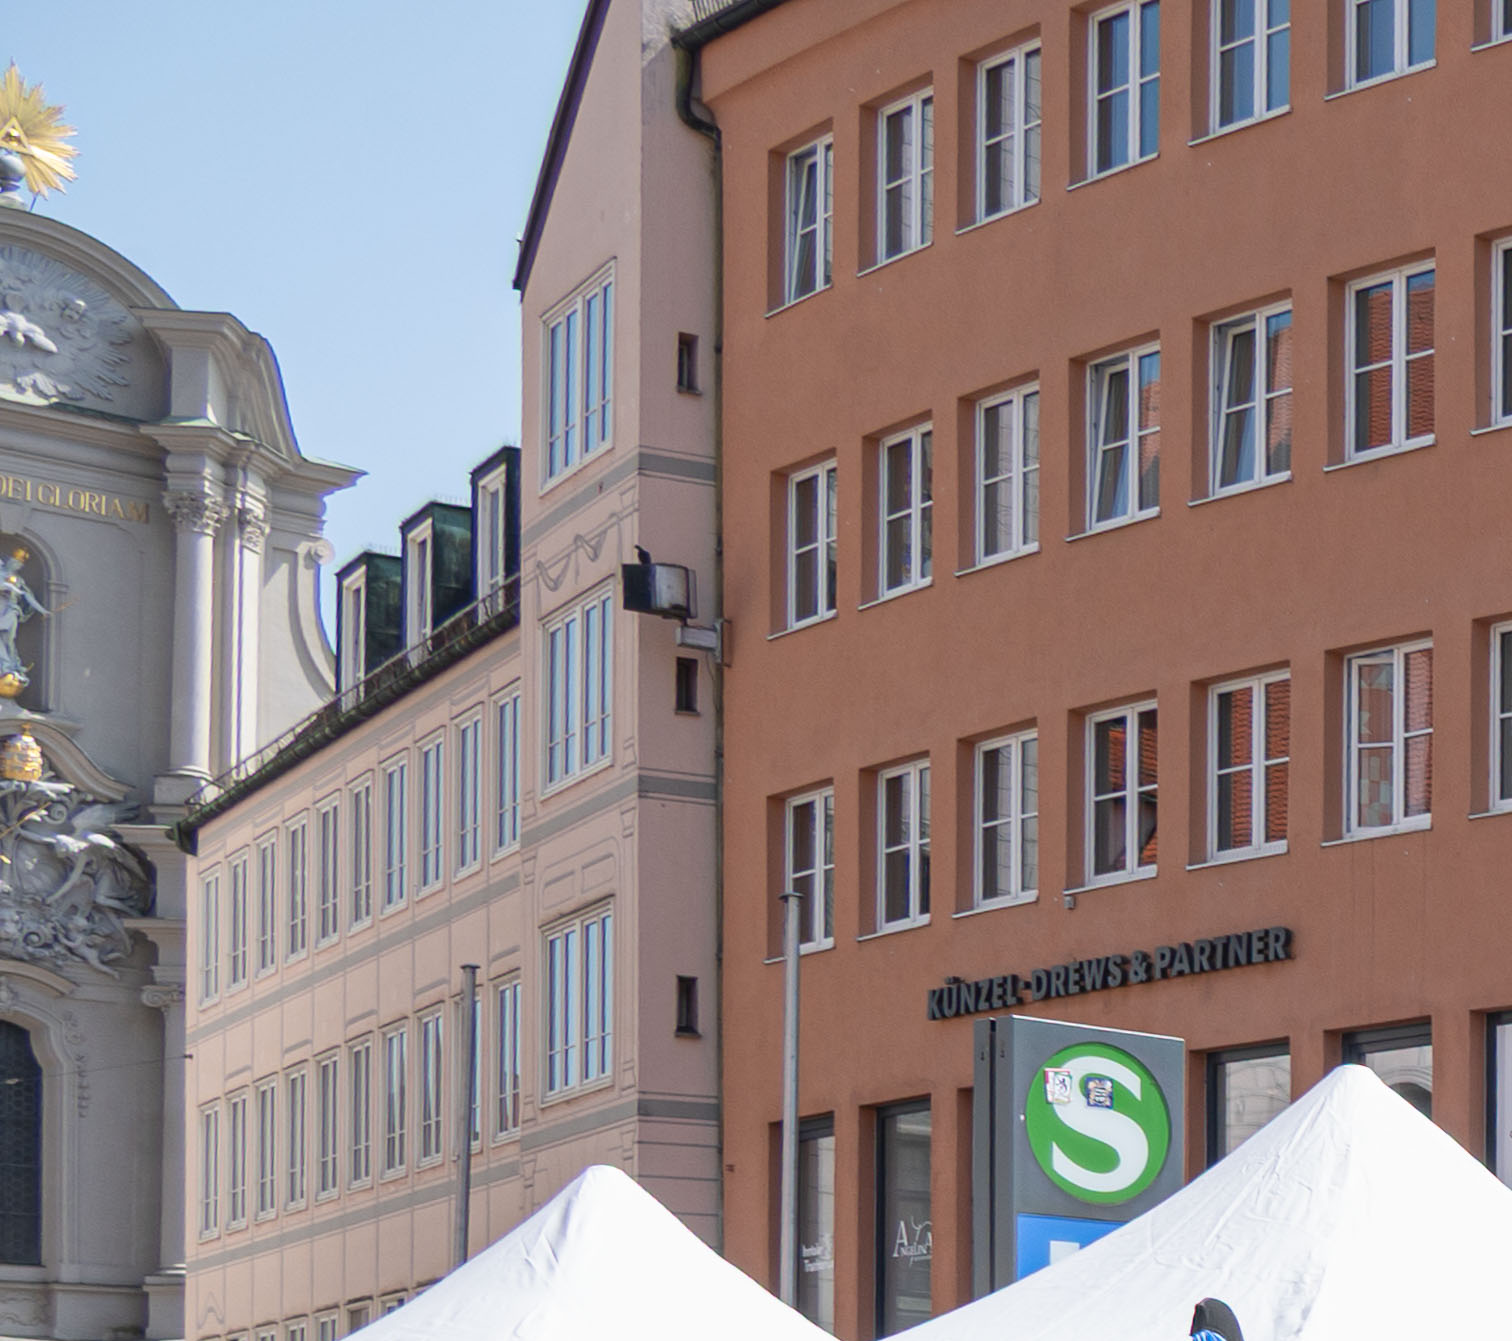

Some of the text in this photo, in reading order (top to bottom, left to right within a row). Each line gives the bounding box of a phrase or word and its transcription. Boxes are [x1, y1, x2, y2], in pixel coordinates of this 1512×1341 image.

[37, 483, 149, 523] GLORIAM
[1128, 951, 1150, 983] &
[1154, 926, 1293, 979] PARTNER
[1052, 1056, 1149, 1192] S
